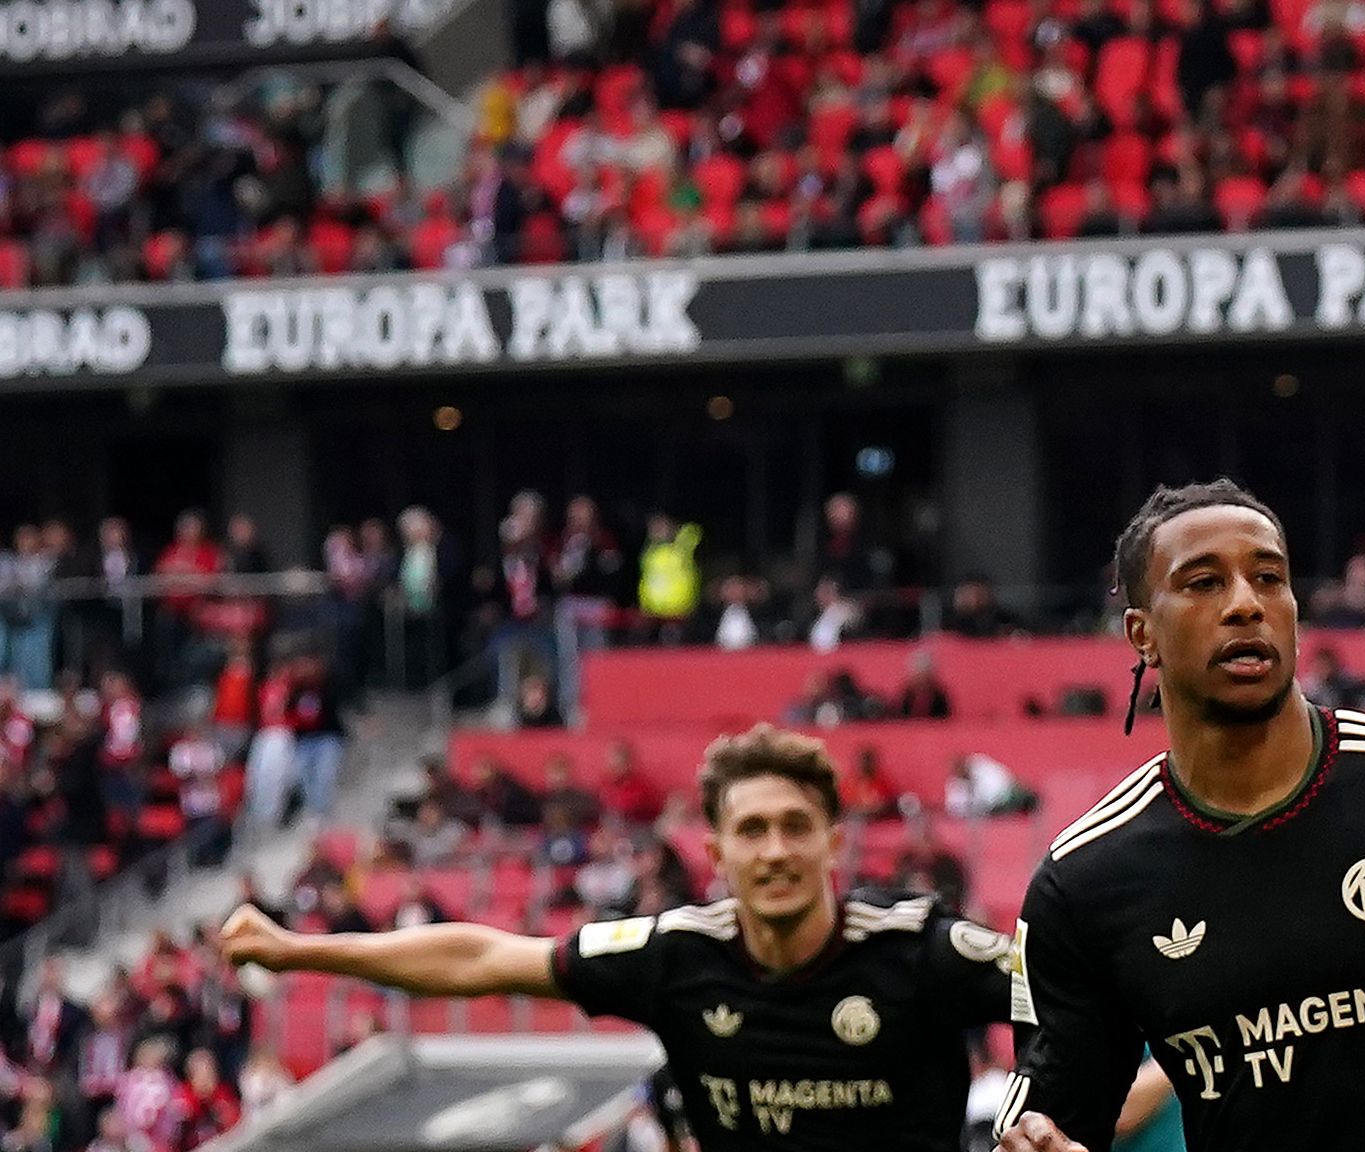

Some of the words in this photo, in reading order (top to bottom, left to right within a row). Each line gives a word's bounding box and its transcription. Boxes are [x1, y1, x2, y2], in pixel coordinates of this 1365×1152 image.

[0, 0, 198, 61] OBRAD
[973, 242, 1295, 343] EUROPA
[222, 281, 503, 376] EUROPA
[508, 271, 702, 356] PARK
[749, 1079, 893, 1109] MAGENTA
[1244, 1046, 1294, 1088] TV
